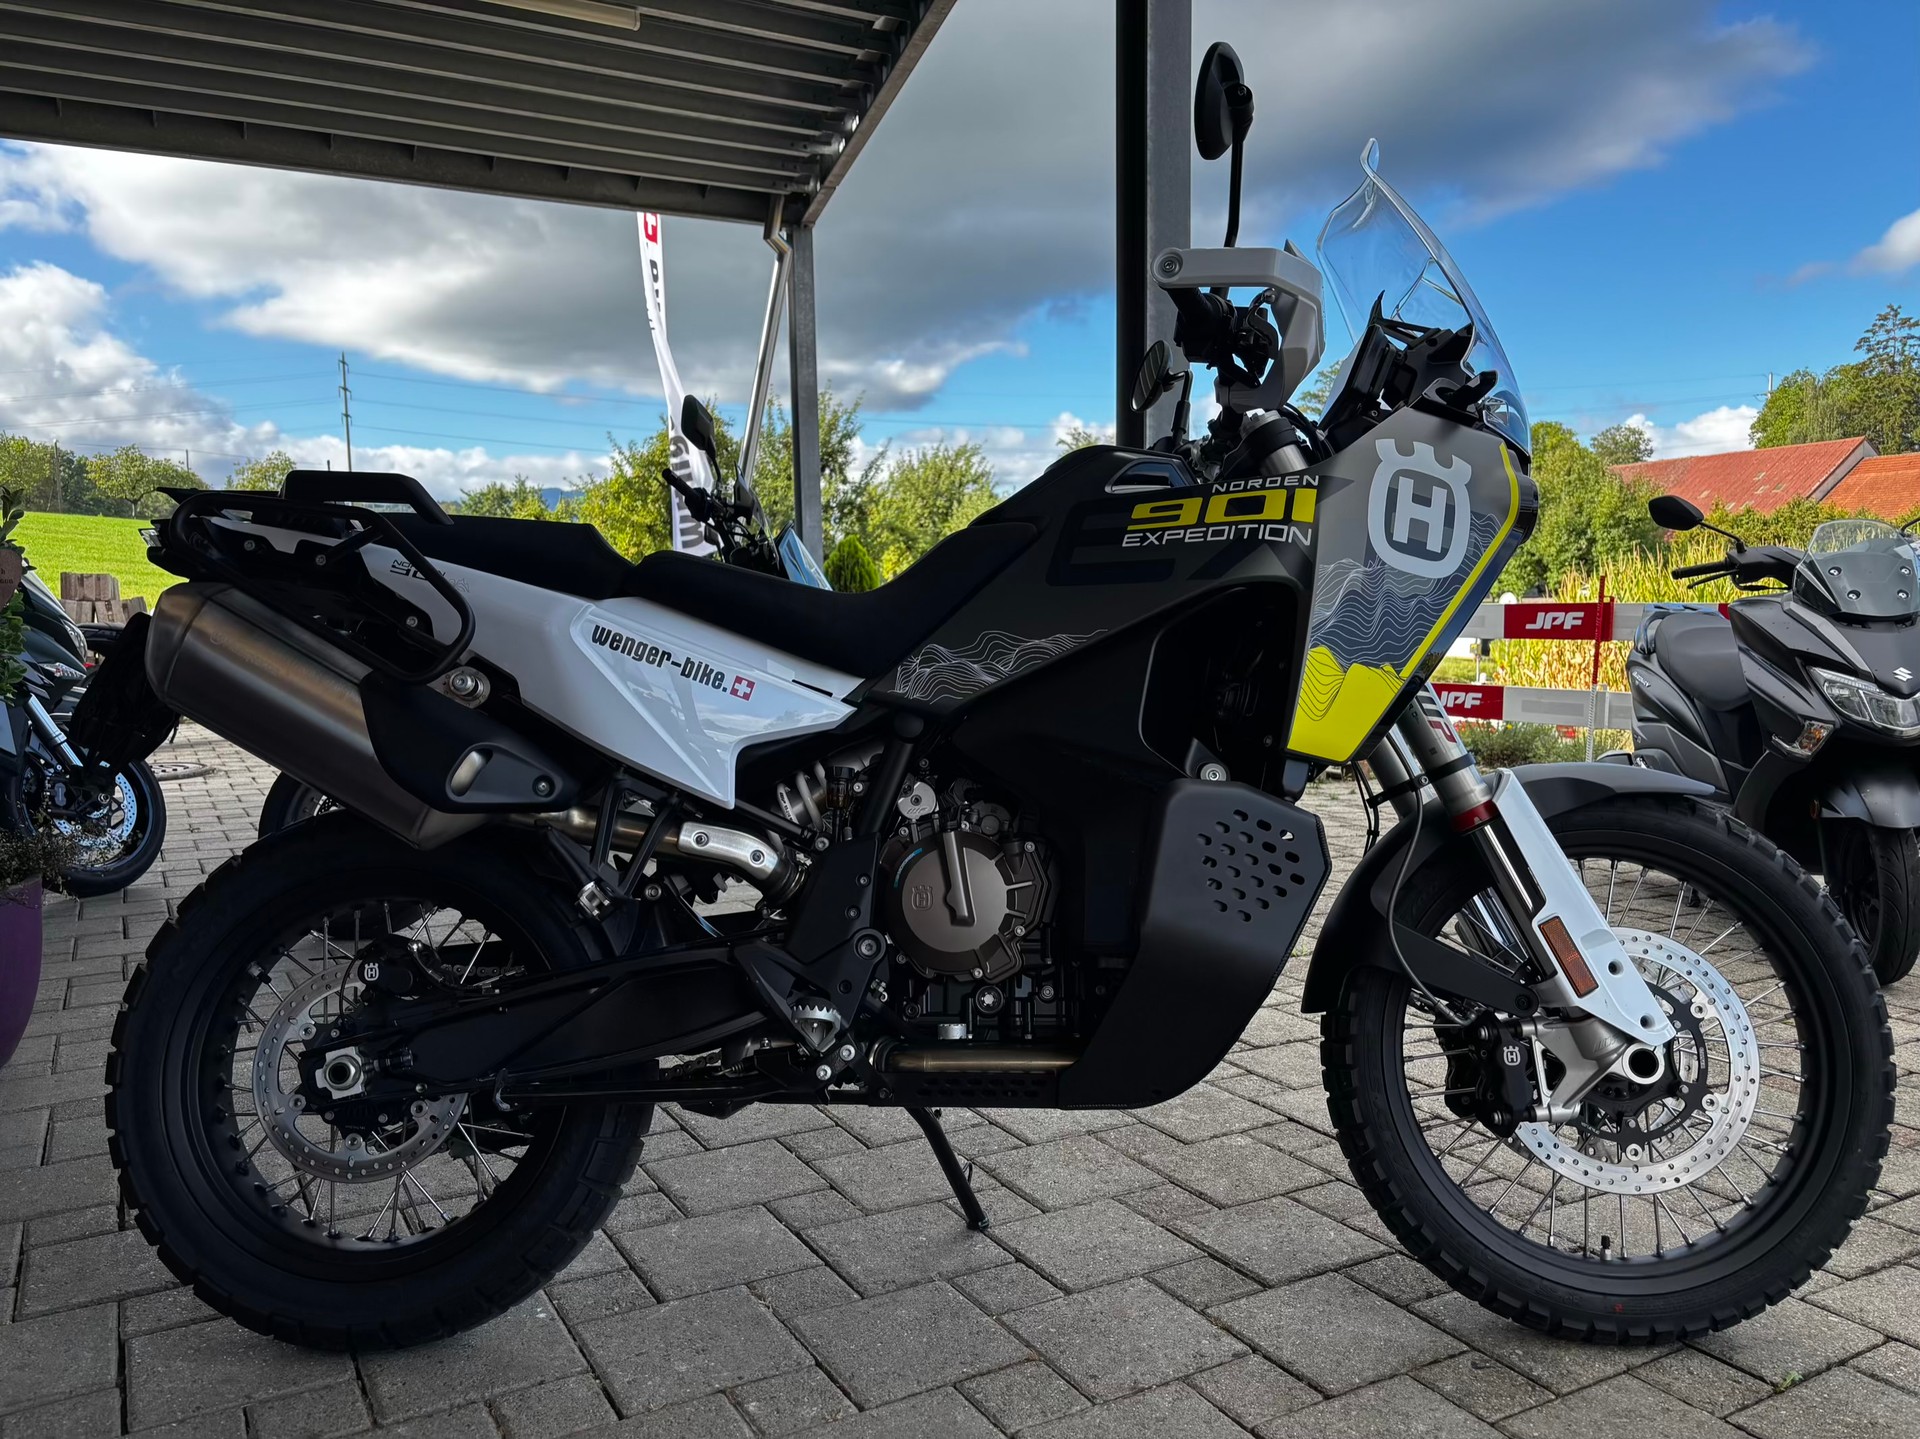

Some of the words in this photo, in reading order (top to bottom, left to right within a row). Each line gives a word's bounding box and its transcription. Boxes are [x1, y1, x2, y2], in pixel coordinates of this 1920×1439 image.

[1212, 475, 1319, 493] NORDEN
[1127, 488, 1318, 530] 901
[1122, 524, 1312, 547] EXPEDITION
[1526, 611, 1584, 630] JPF
[591, 624, 728, 693] wenger-bike.
